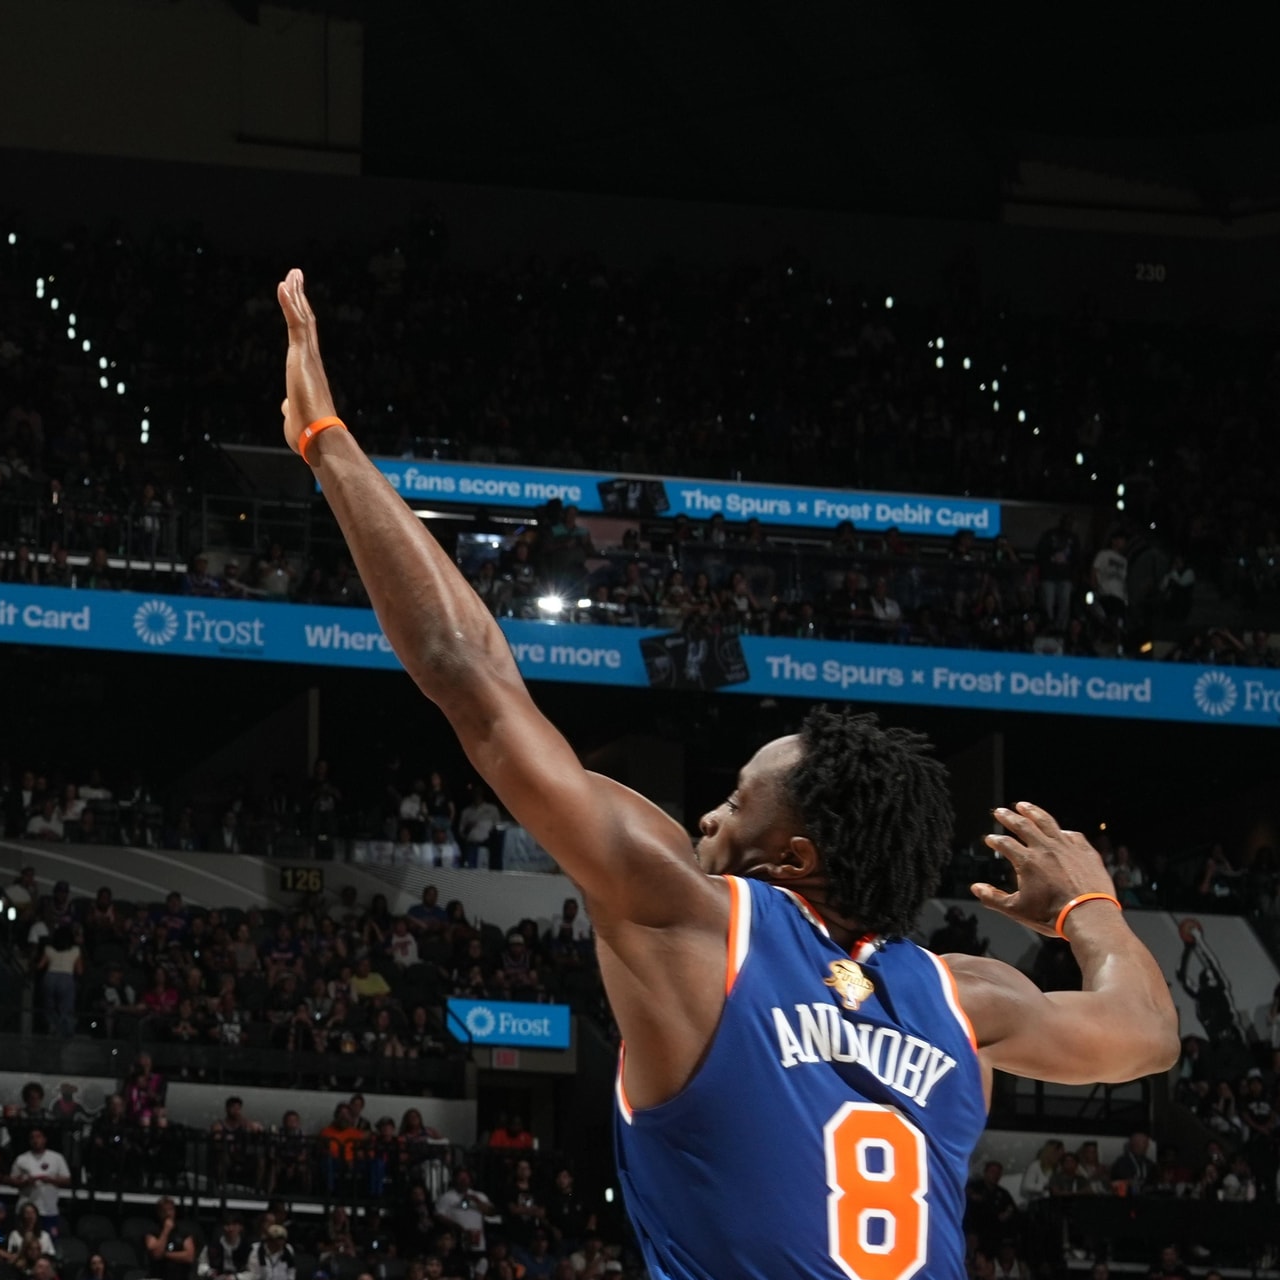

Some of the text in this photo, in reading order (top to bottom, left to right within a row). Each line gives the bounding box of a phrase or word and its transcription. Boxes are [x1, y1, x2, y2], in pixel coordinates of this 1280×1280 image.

[403, 467, 455, 493] fans
[458, 474, 521, 498] score
[525, 481, 581, 502] more
[681, 489, 723, 511] The
[726, 493, 792, 517] Spurs
[814, 498, 873, 523] Frost
[877, 503, 934, 527] Debit
[937, 507, 989, 530] Card
[23, 604, 91, 632] Card
[184, 610, 265, 647] Frost
[551, 643, 622, 669] more
[766, 656, 819, 681] The
[822, 660, 904, 687] Spurs
[933, 667, 1005, 694] Frost
[1011, 672, 1083, 699] Debit
[1087, 677, 1151, 703] Card
[282, 869, 322, 891] 126
[498, 1011, 552, 1037] Frost
